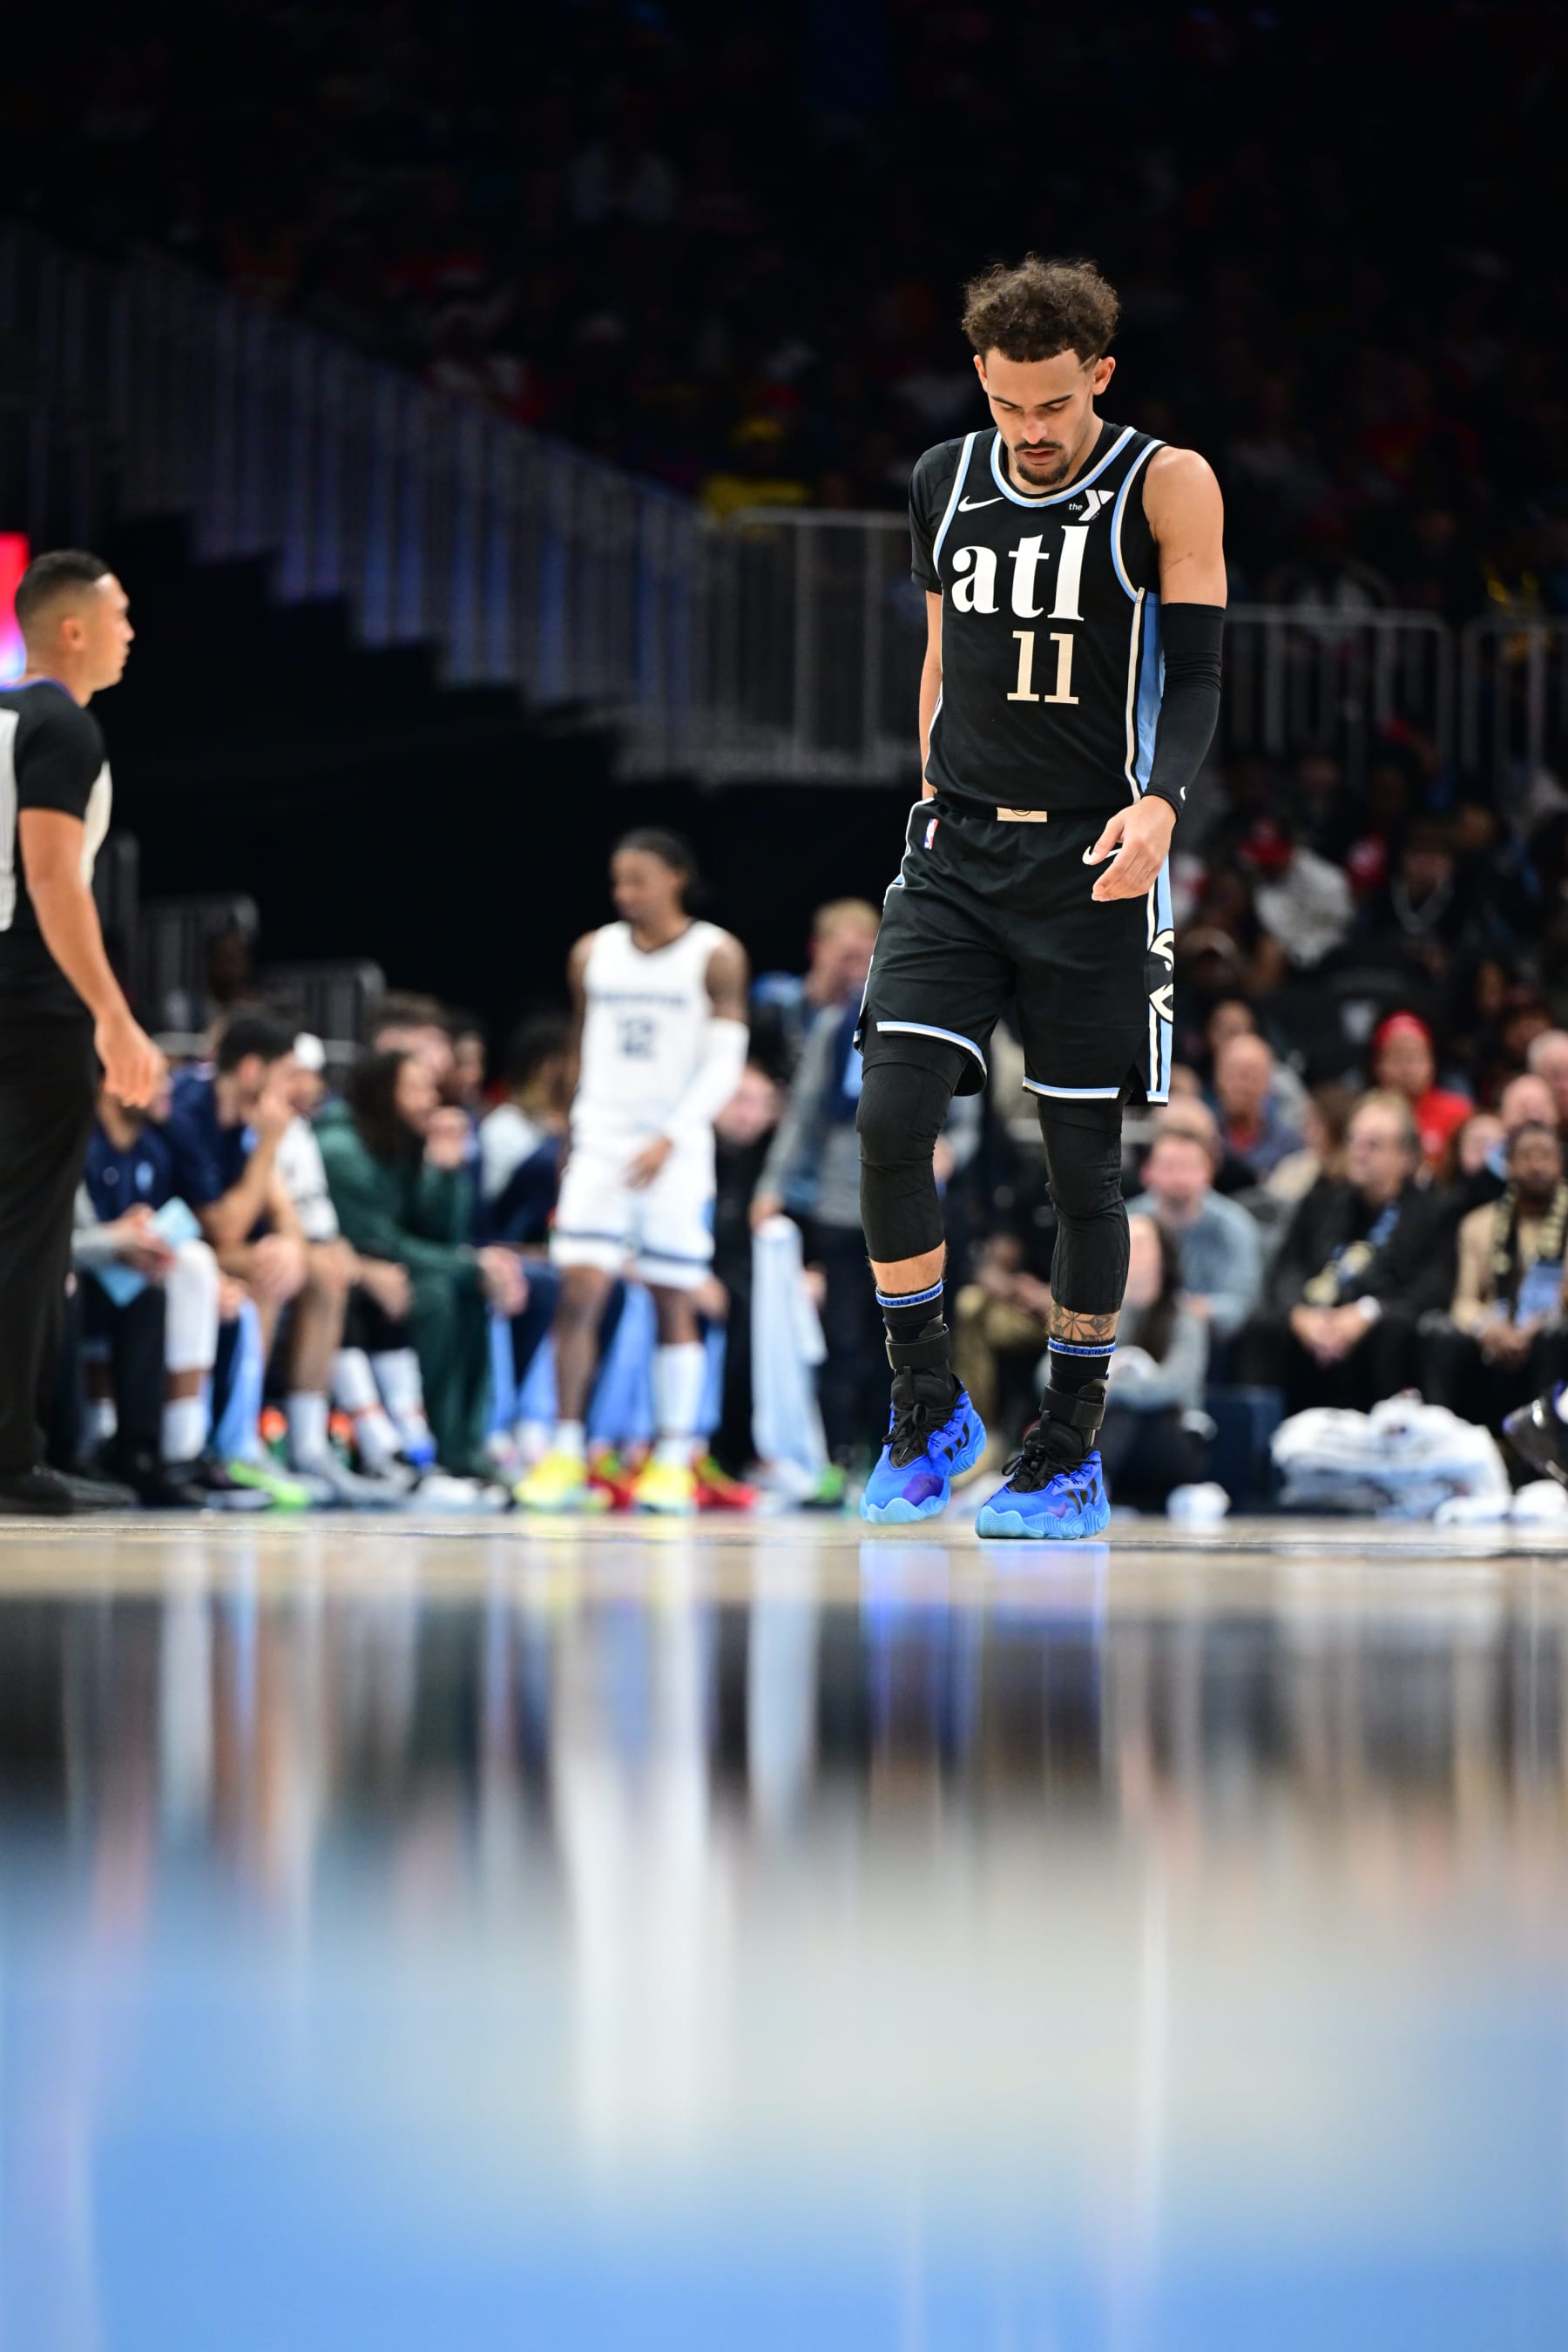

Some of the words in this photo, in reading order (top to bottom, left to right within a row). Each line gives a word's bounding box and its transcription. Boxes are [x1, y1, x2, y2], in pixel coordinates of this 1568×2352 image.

[1069, 503, 1083, 511] the
[951, 525, 1089, 621] atl
[1007, 631, 1078, 704] 11
